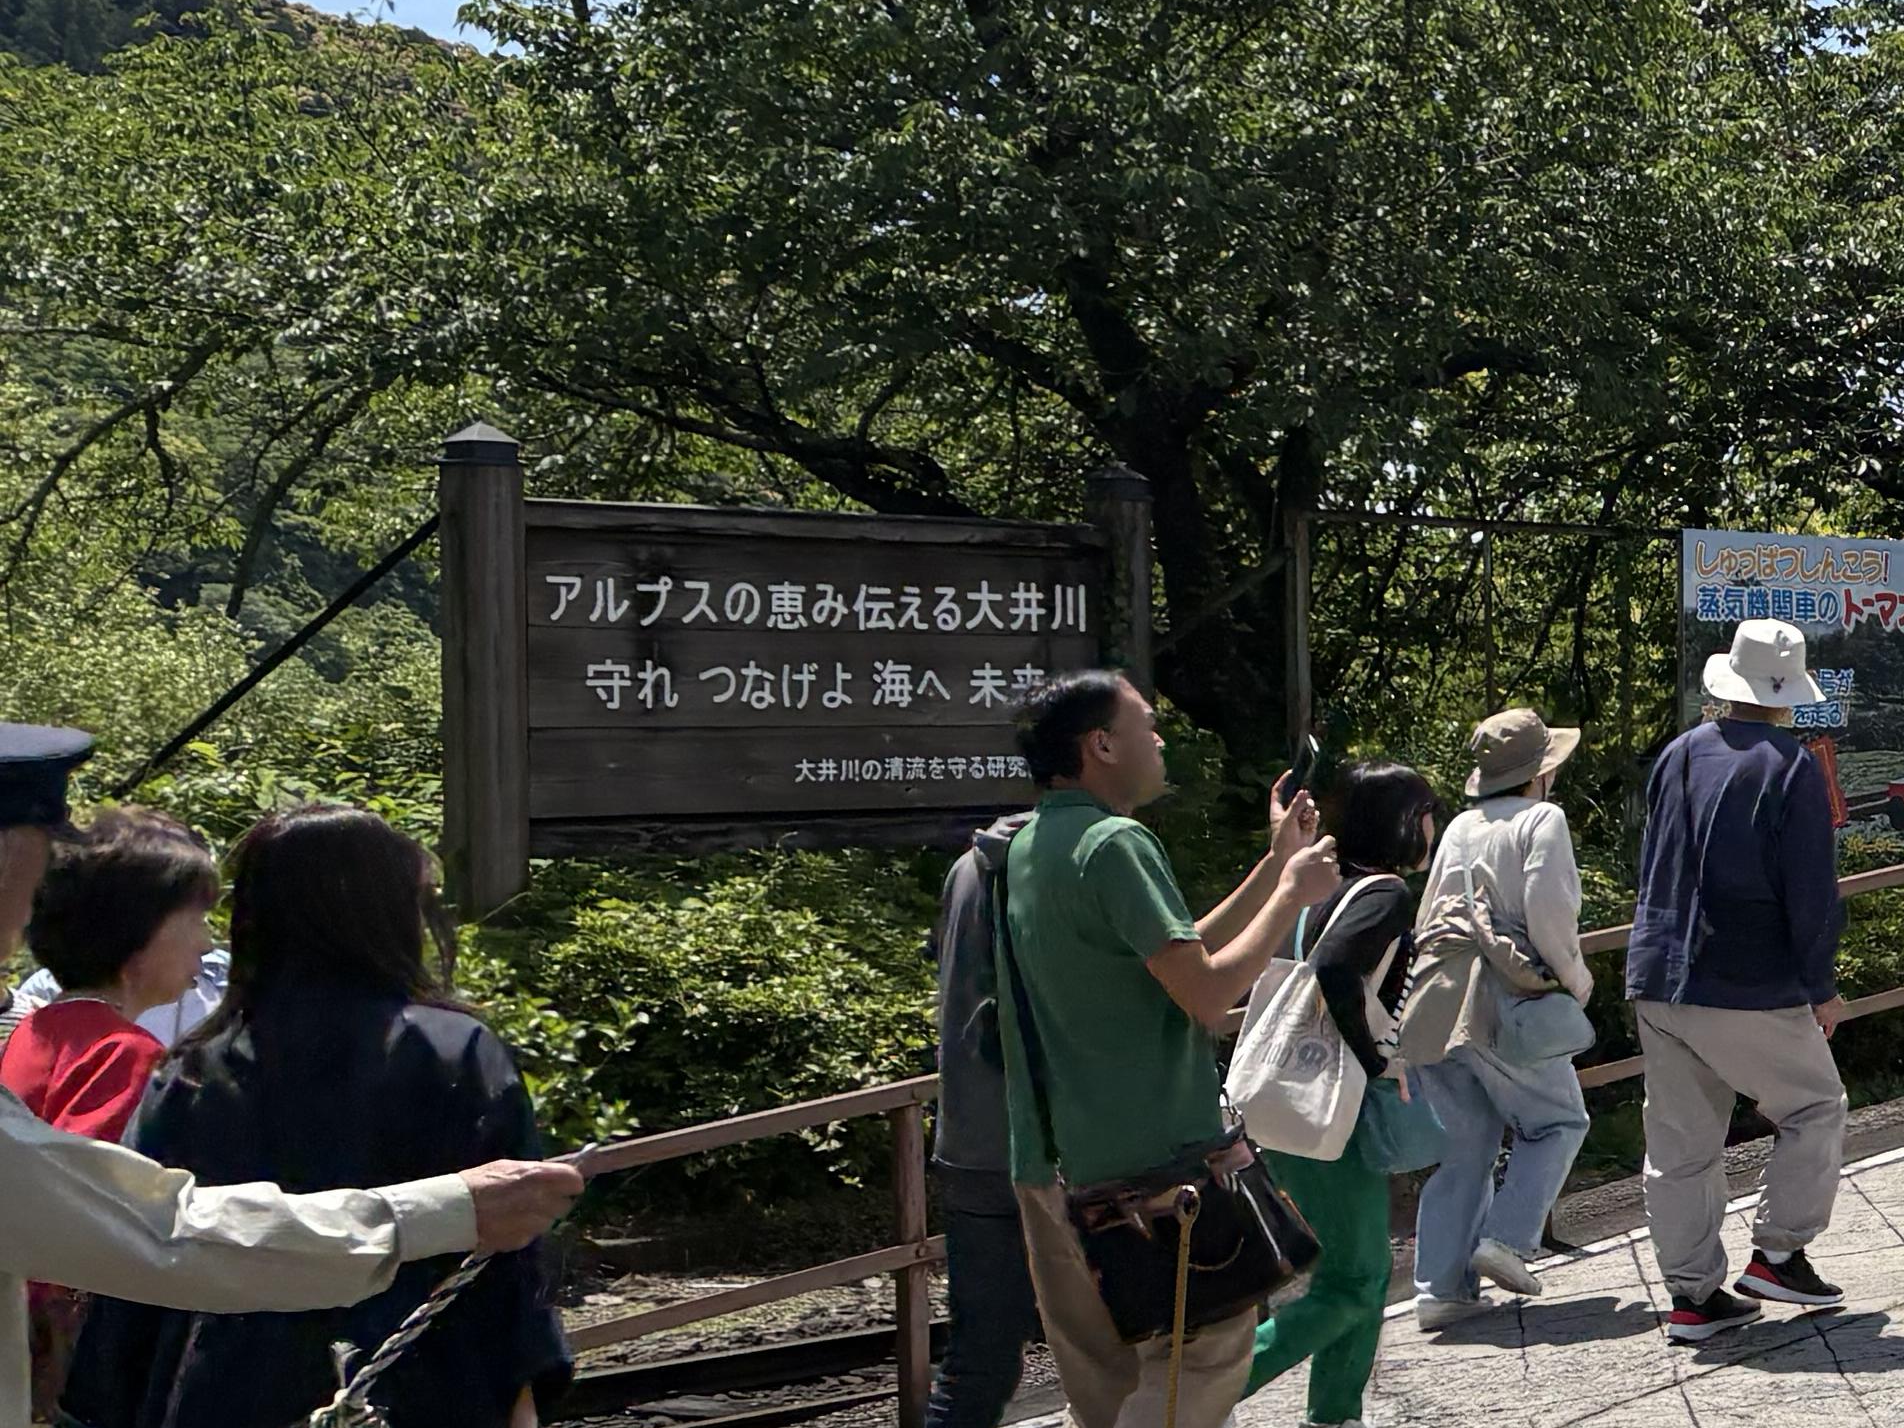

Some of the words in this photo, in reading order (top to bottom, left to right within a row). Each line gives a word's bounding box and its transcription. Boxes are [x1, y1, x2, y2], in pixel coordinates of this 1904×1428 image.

[545, 575, 1087, 633] アルプスの恵み伝える大井川
[586, 659, 679, 710] 守れ
[699, 660, 853, 710] つなげよ
[872, 660, 951, 708] 海へ
[794, 756, 1033, 782] 大井川の清流を守る研究
